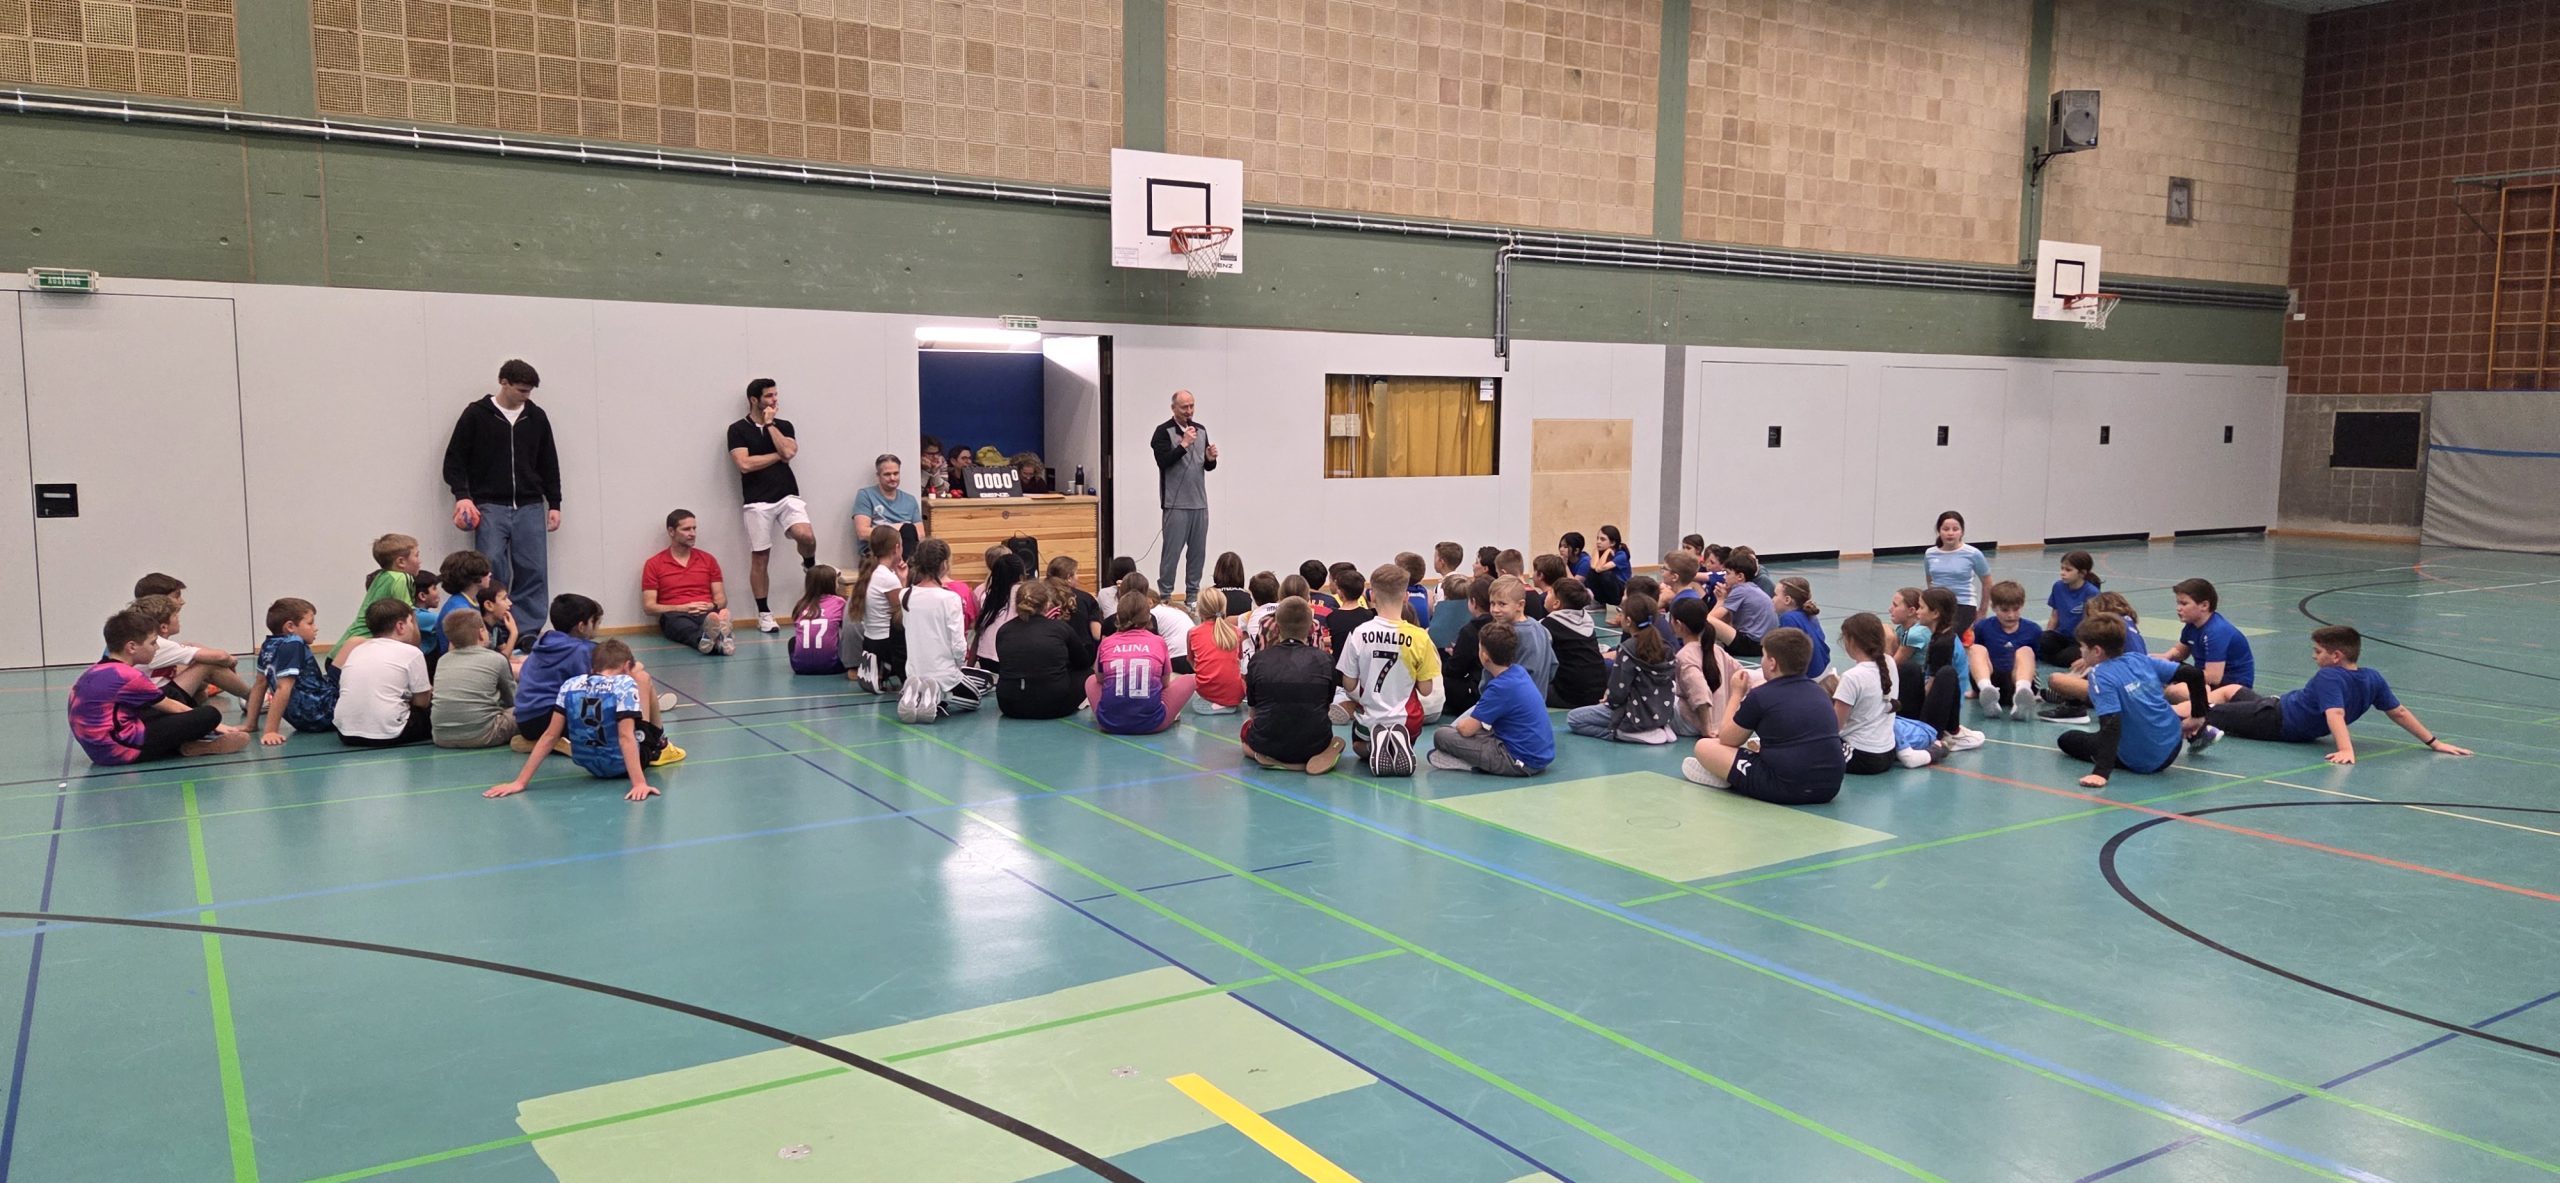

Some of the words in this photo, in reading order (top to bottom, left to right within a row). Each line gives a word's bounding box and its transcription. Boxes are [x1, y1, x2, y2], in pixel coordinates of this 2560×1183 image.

[800, 619, 829, 649] 17
[1113, 644, 1150, 654] ALINA
[1362, 631, 1413, 647] RONALDO
[1110, 658, 1151, 699] 10
[1372, 650, 1399, 693] 7
[580, 697, 608, 747] 9
